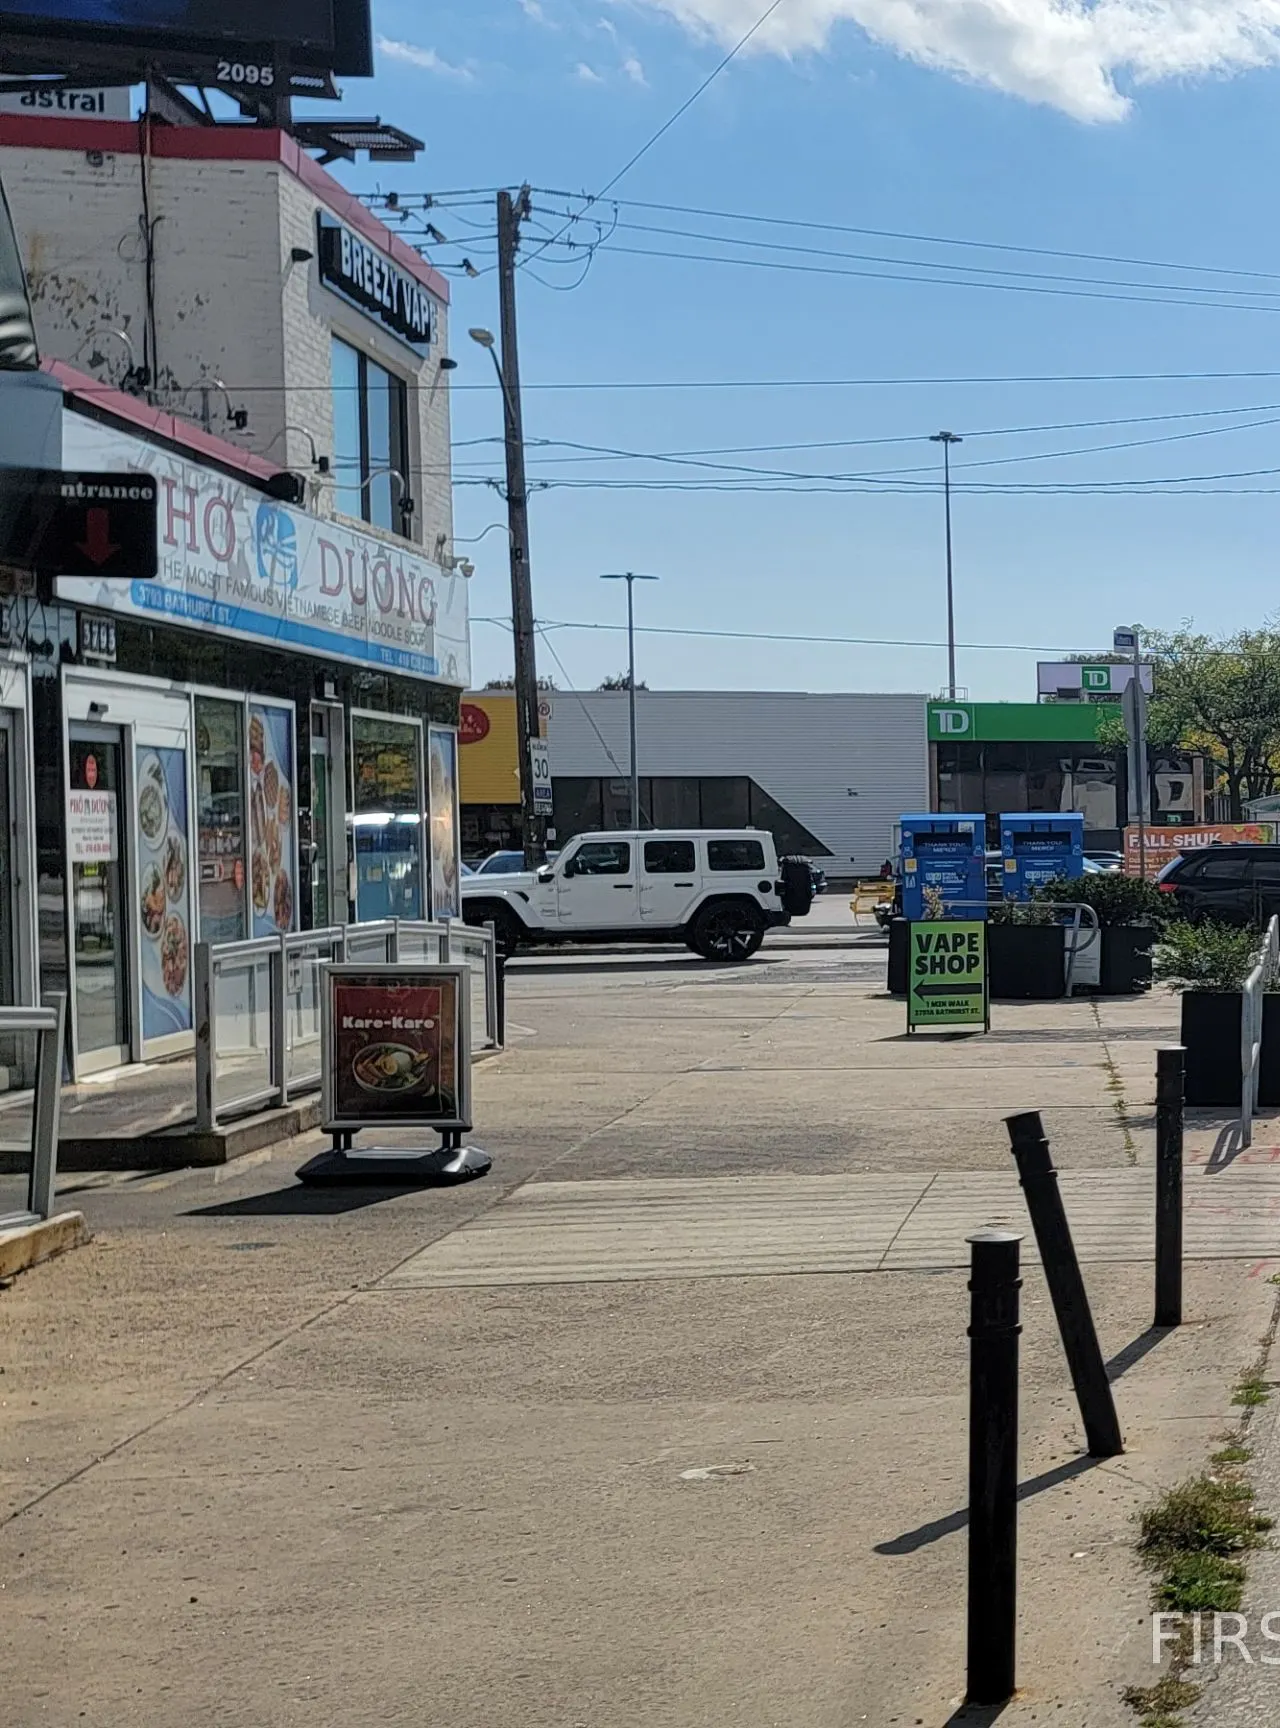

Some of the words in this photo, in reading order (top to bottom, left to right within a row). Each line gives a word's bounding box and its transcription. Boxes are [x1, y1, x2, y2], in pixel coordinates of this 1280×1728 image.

[217, 61, 274, 86] 2095
[20, 88, 105, 113] astral
[339, 232, 400, 315] BREEZY
[400, 283, 439, 345] VAPE
[60, 481, 154, 500] ntrance
[163, 558, 182, 580] HE
[186, 565, 222, 590] MOST
[226, 578, 273, 607] FAMOUS
[341, 611, 366, 632] BEEF
[368, 619, 402, 641] NOODLE
[404, 629, 426, 647] SOUP
[1083, 670, 1108, 686] TD
[931, 709, 970, 734] TD
[534, 758, 549, 778] 30
[1128, 833, 1172, 848] FALL
[1172, 832, 1222, 847] SHUK
[915, 932, 979, 954] VAPE
[915, 954, 980, 975] SHOP
[936, 1007, 969, 1016] BATHURST
[948, 999, 970, 1008] WALK
